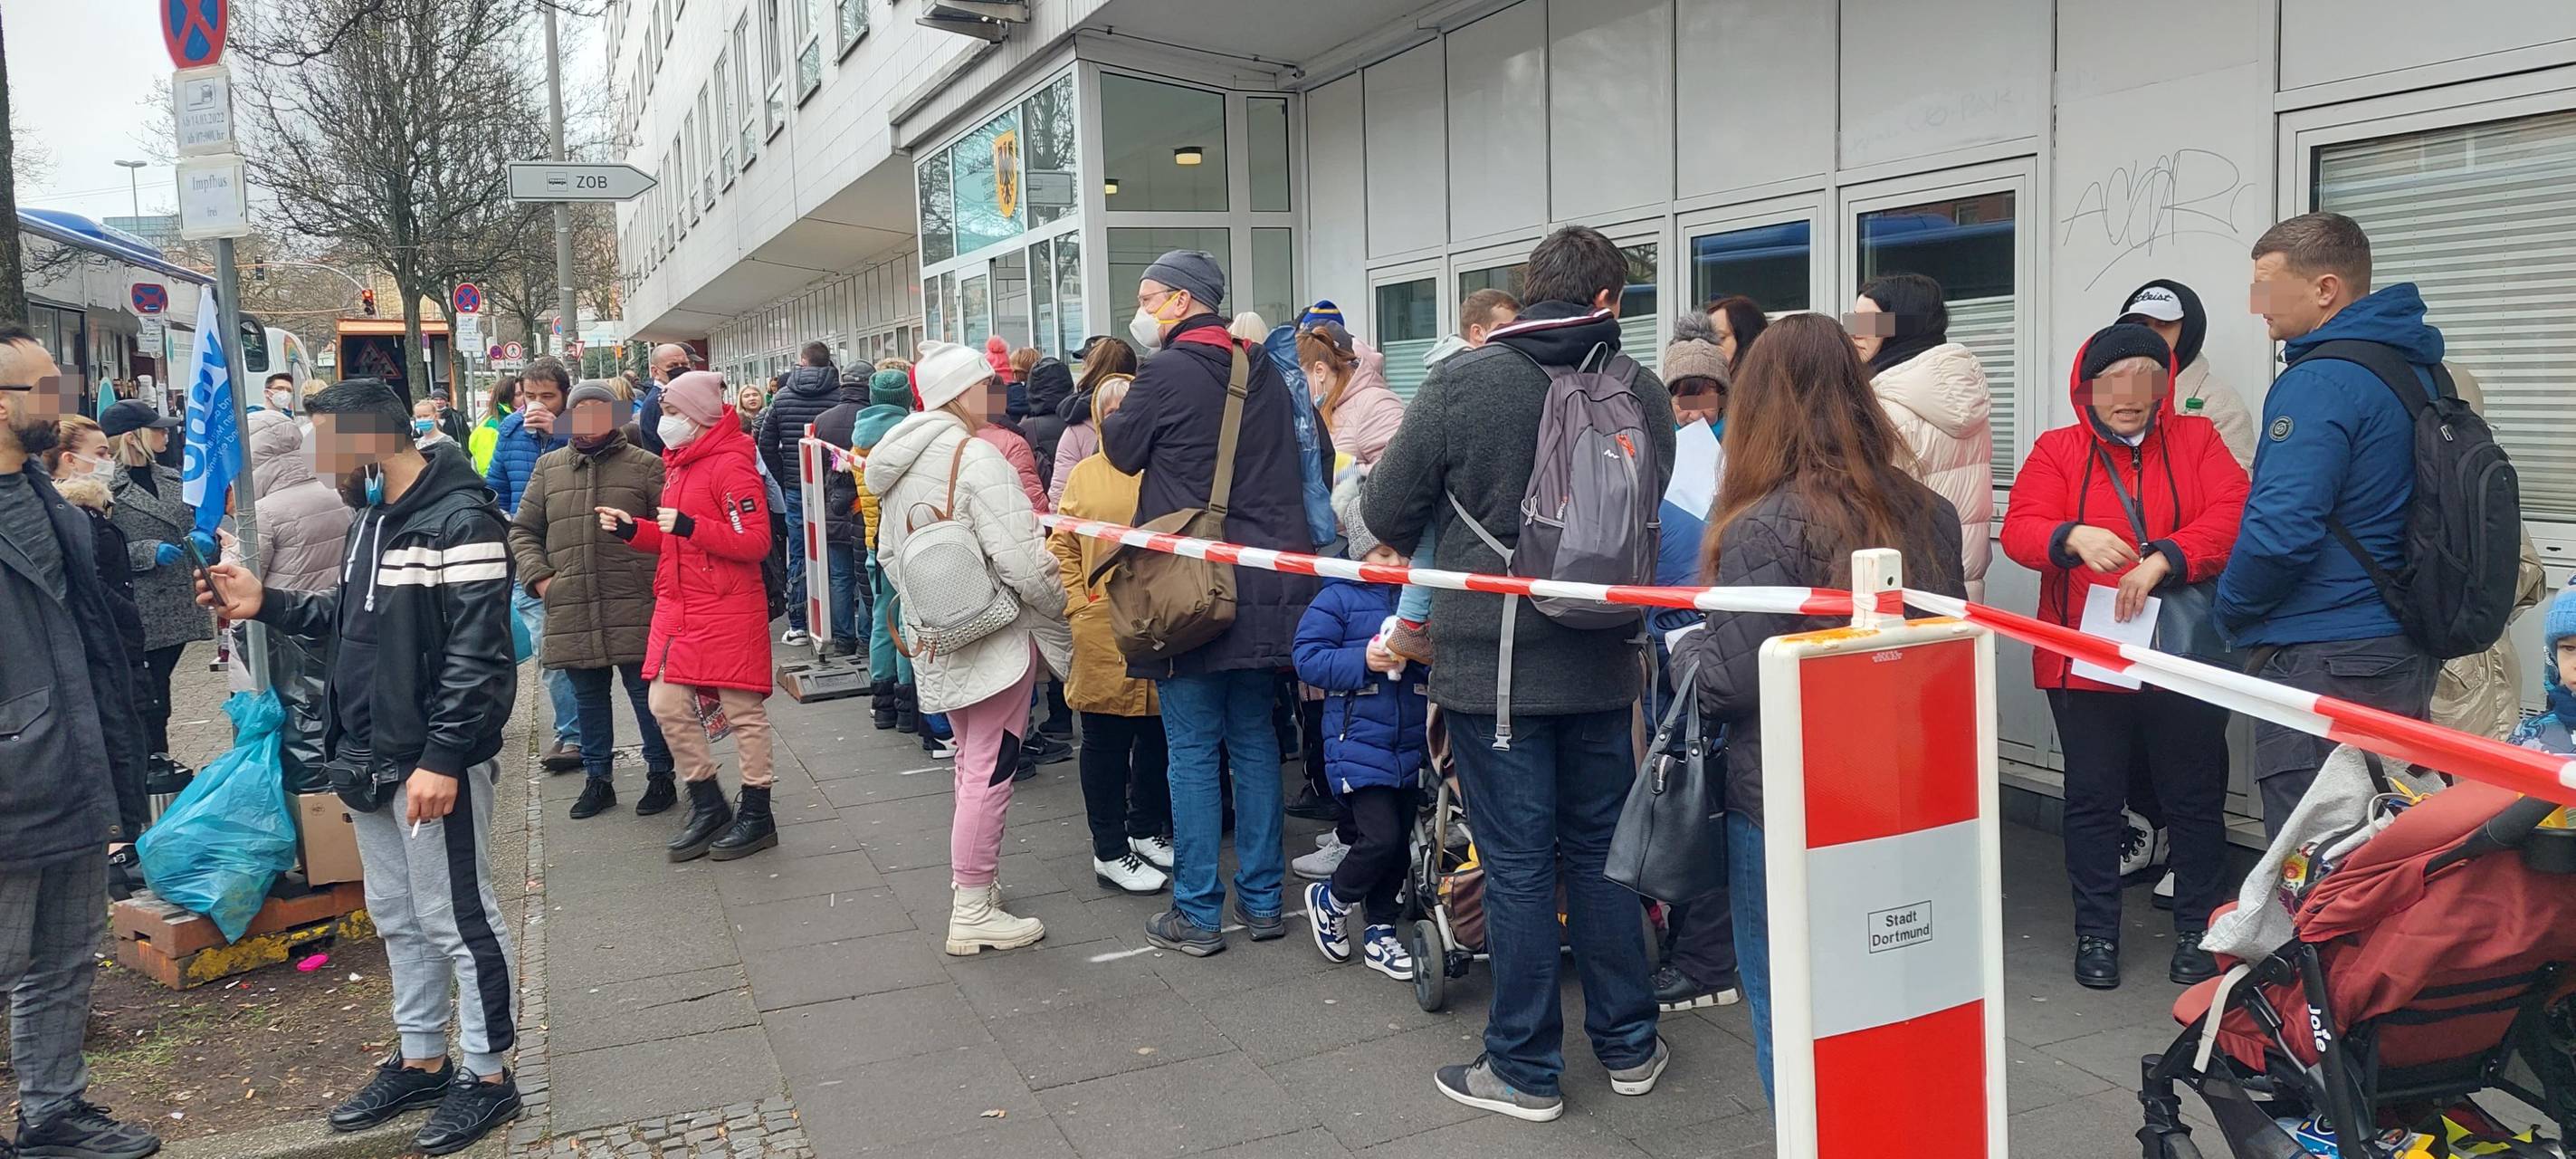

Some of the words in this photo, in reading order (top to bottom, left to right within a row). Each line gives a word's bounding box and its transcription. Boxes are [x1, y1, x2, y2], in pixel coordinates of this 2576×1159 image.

[192, 174, 228, 193] Impfbus
[576, 176, 607, 188] ZOB
[1885, 910, 1917, 927] Stadt
[1872, 923, 1930, 947] Dortmund
[2308, 1003, 2332, 1052] Joie
